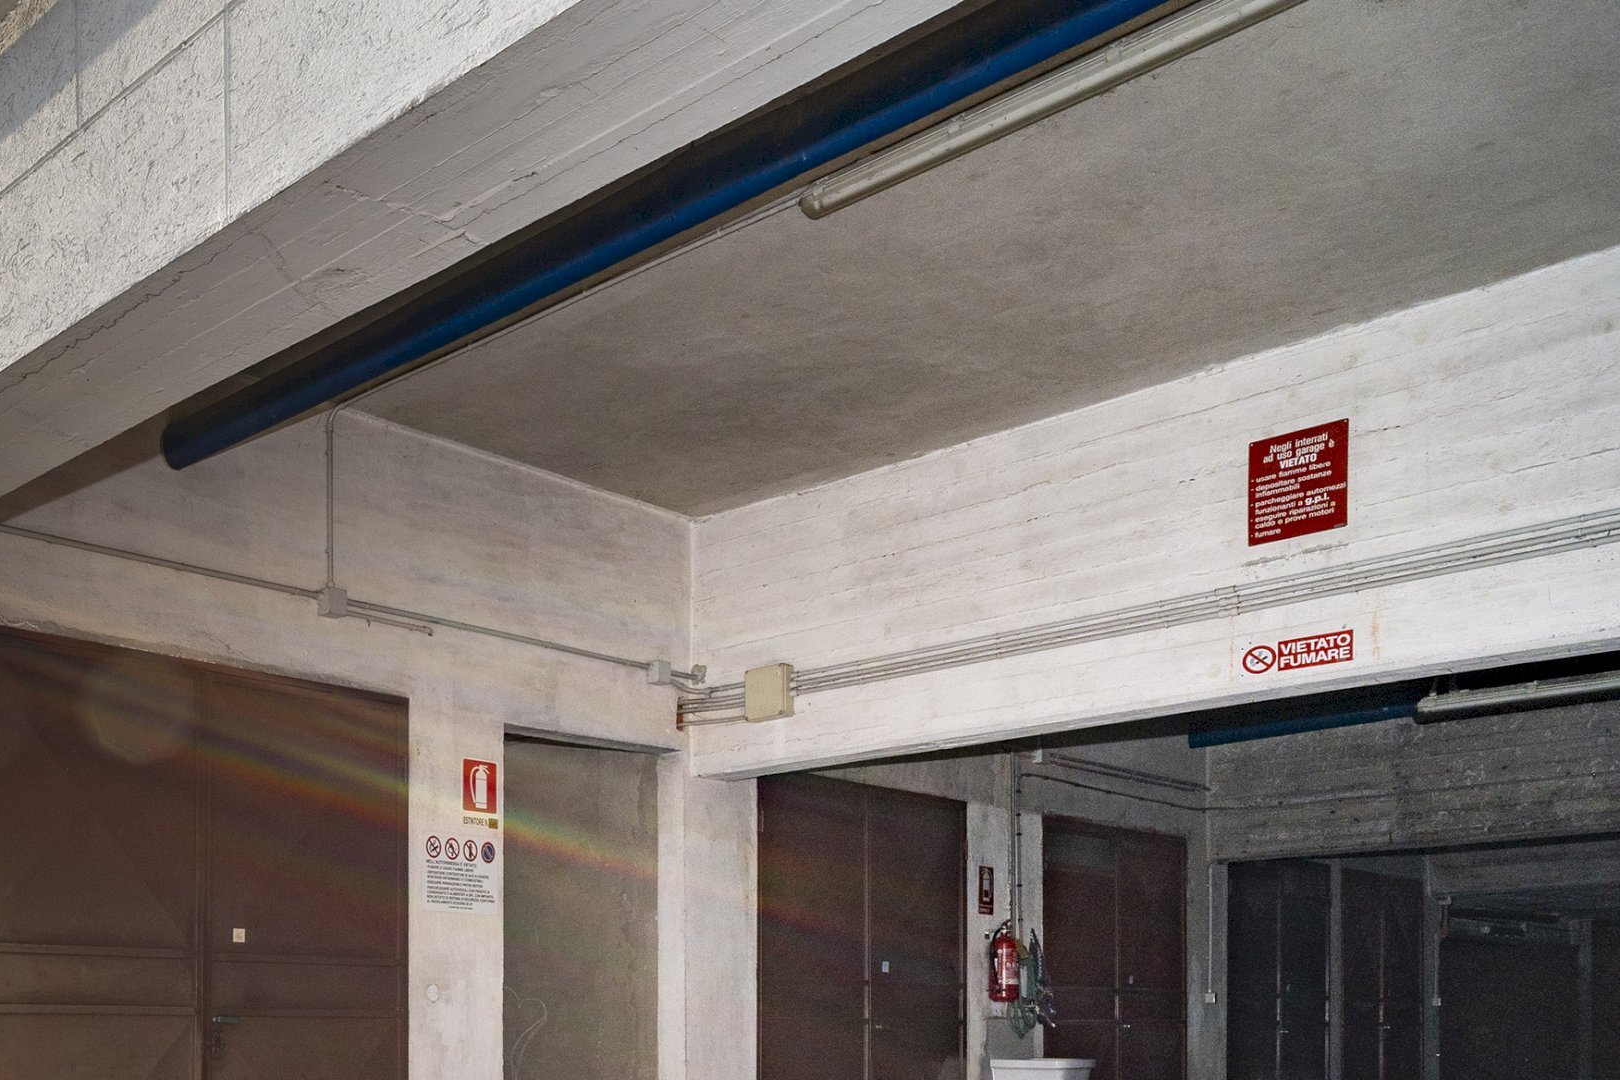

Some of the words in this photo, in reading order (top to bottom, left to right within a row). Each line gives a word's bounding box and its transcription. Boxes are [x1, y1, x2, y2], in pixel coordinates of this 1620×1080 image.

[1263, 454, 1273, 463] ad
[1277, 451, 1292, 460] uso
[1296, 442, 1325, 457] garage
[1270, 441, 1292, 454] Negli
[1295, 432, 1328, 448] interrati
[1279, 453, 1317, 469] VIETATO
[1255, 478, 1295, 492] depositare
[1297, 470, 1332, 482] sostanze
[1256, 474, 1276, 483] usare
[1279, 466, 1307, 477] fiamme
[1309, 461, 1331, 471] libere
[1255, 484, 1300, 498] infiammabili
[1255, 492, 1304, 508] parcheggiare
[1306, 481, 1346, 496] automezzi
[1255, 502, 1296, 515] funzionanti
[1305, 493, 1330, 505] g.p.l.
[1255, 511, 1287, 523] eseguire
[1289, 502, 1328, 515] riparazioni
[1255, 519, 1275, 529] caldo
[1285, 514, 1307, 524] prove
[1309, 507, 1334, 518] motori
[1255, 528, 1281, 538] fumare
[1280, 634, 1351, 655] VIETATO
[1280, 647, 1351, 668] FUMARE
